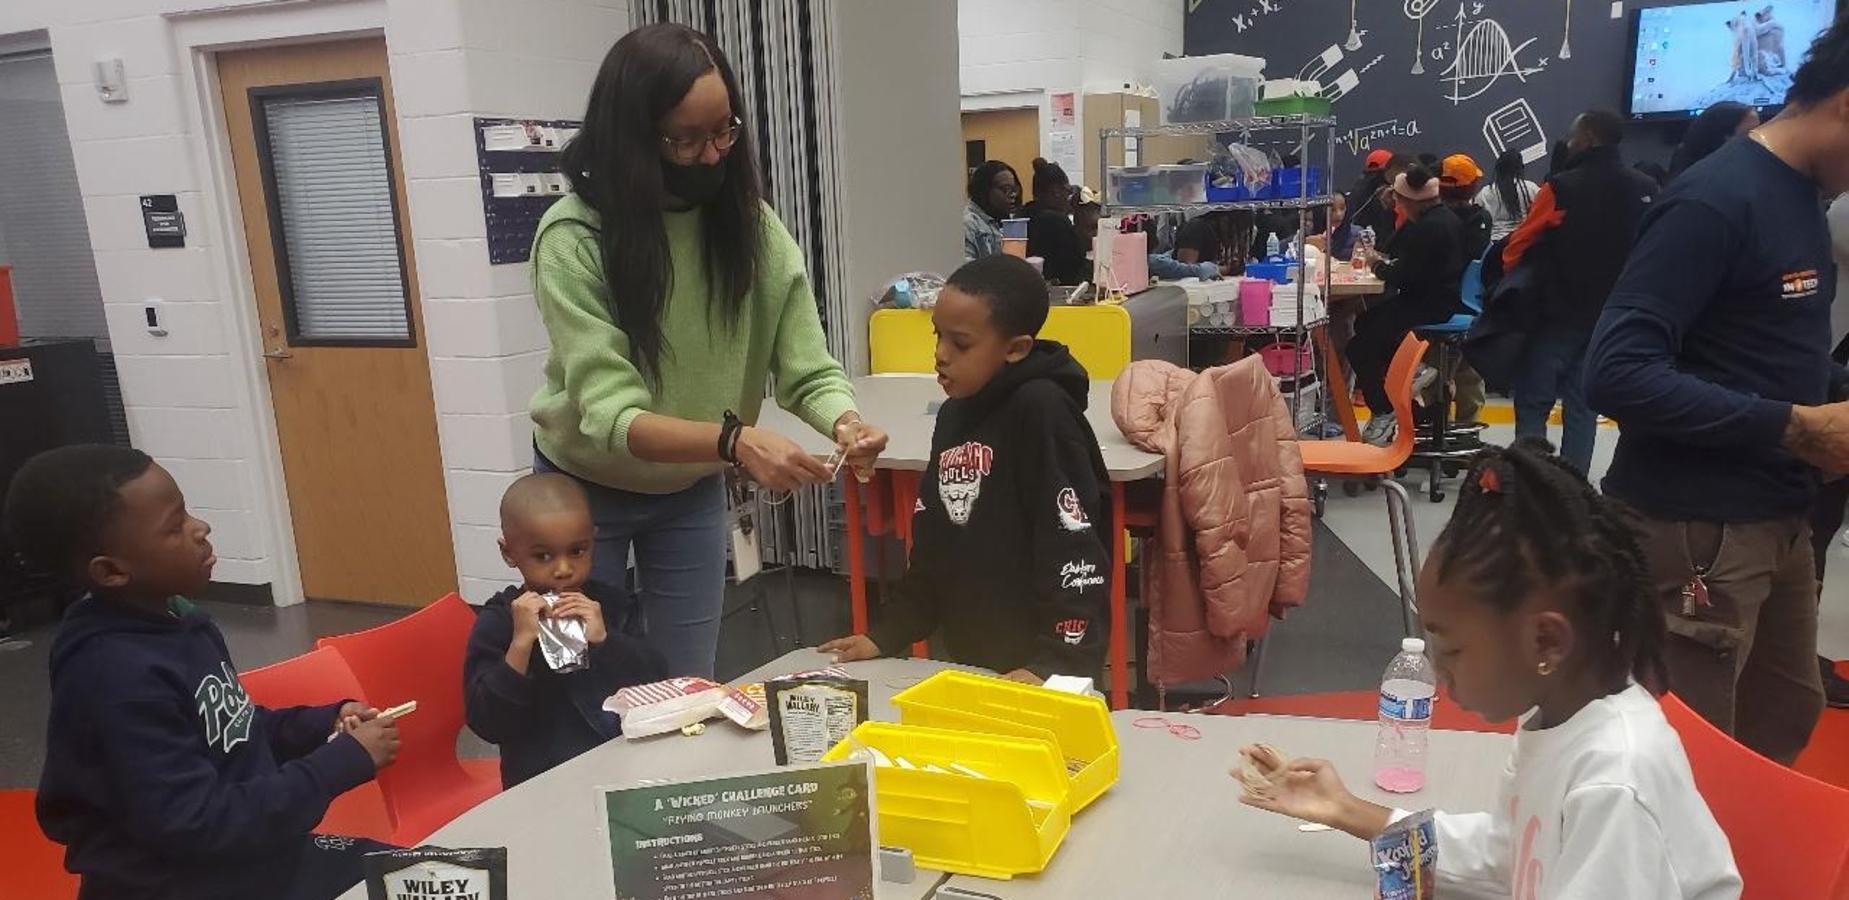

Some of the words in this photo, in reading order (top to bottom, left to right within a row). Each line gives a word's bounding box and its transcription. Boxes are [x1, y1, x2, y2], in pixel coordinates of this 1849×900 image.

[142, 198, 153, 208] 42
[654, 799, 664, 811] A
[721, 786, 785, 802] CHALLENGE
[788, 782, 819, 795] CARD
[707, 807, 749, 821] MONKEY
[402, 879, 470, 895] WILEY
